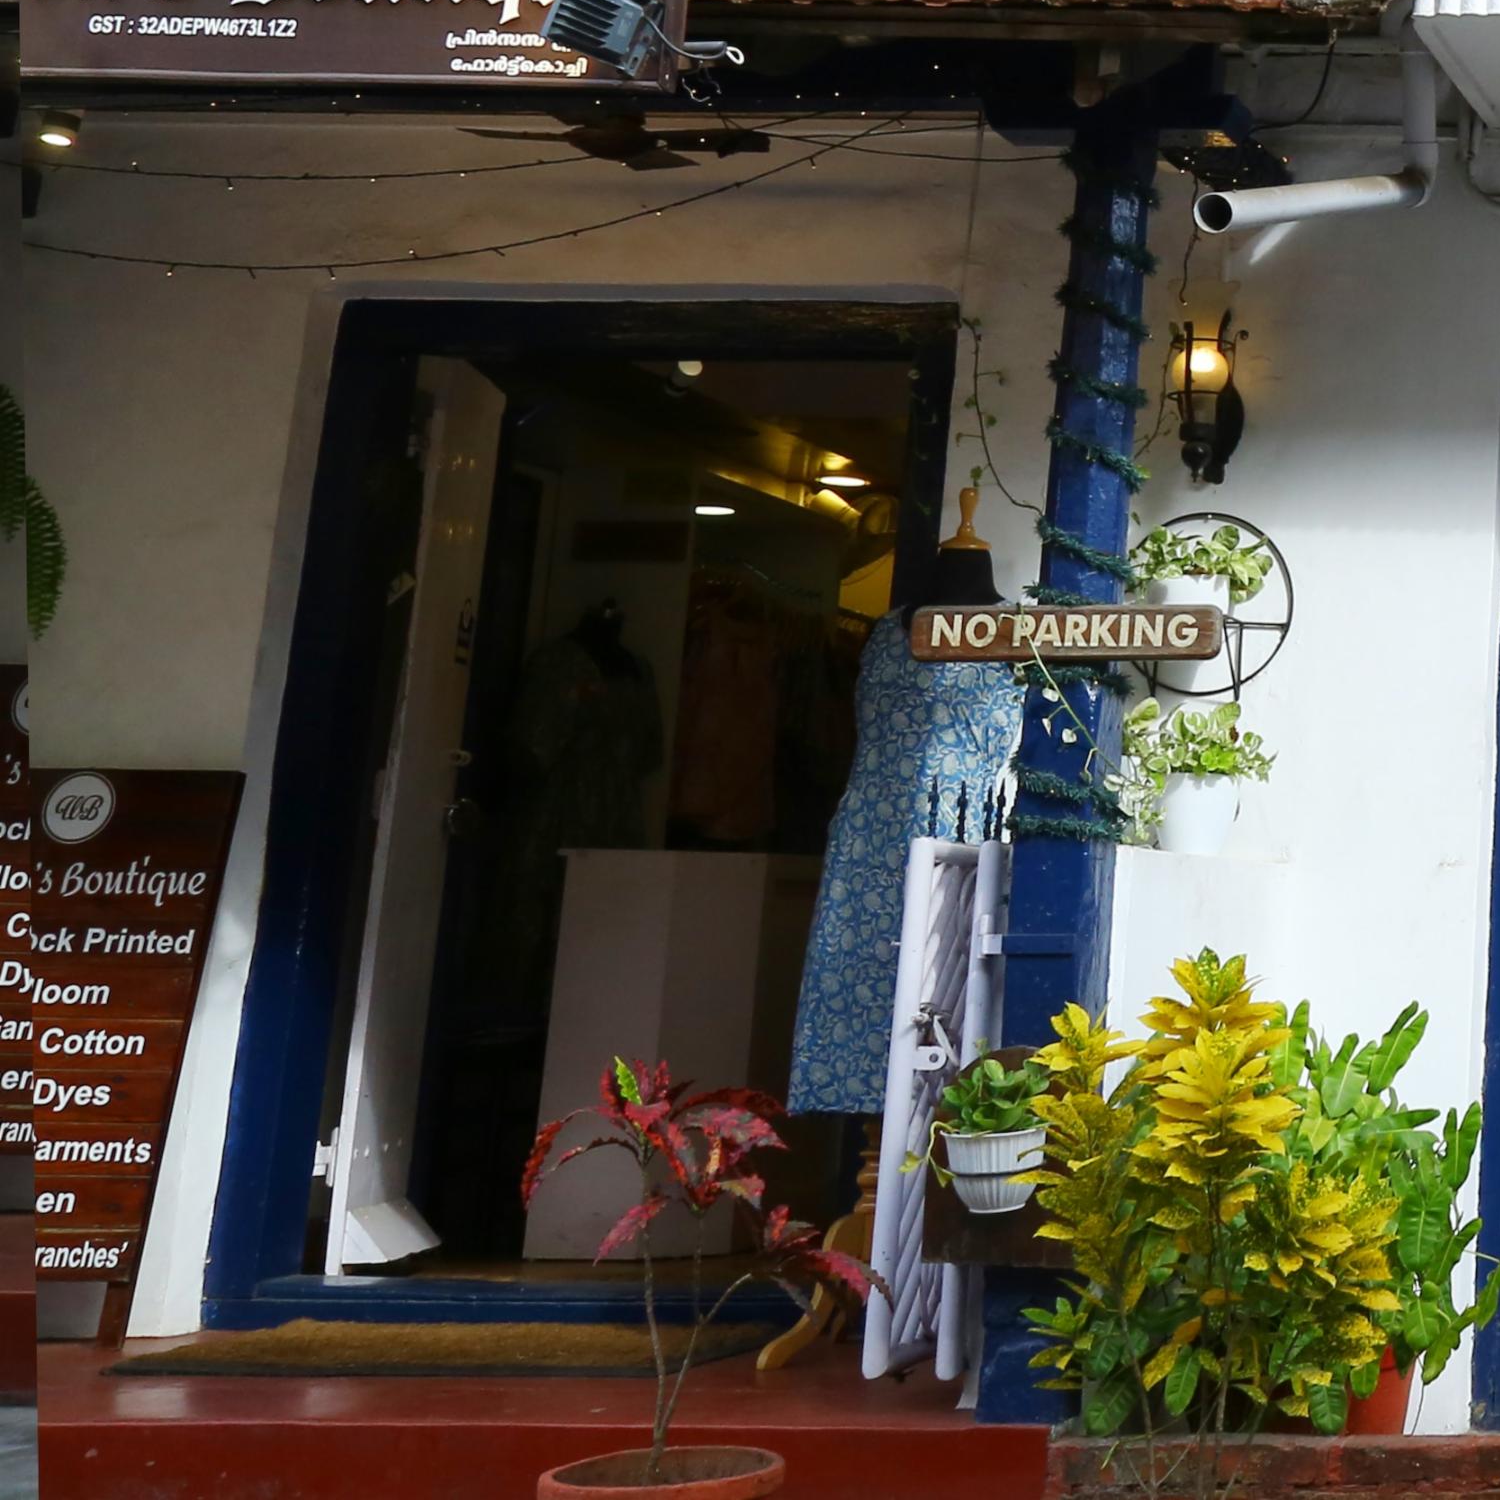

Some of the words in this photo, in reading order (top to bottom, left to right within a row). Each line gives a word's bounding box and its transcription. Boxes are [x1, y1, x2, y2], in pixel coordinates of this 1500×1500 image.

[88, 14, 125, 34] GST
[930, 613, 998, 648] NO
[1011, 612, 1200, 648] PARKING
[60, 854, 207, 908] Boutique
[82, 927, 196, 954] Printed
[32, 978, 110, 1005] loom
[39, 1026, 145, 1056] Cotton
[33, 1077, 112, 1112] Dyes
[34, 1137, 152, 1163] arments
